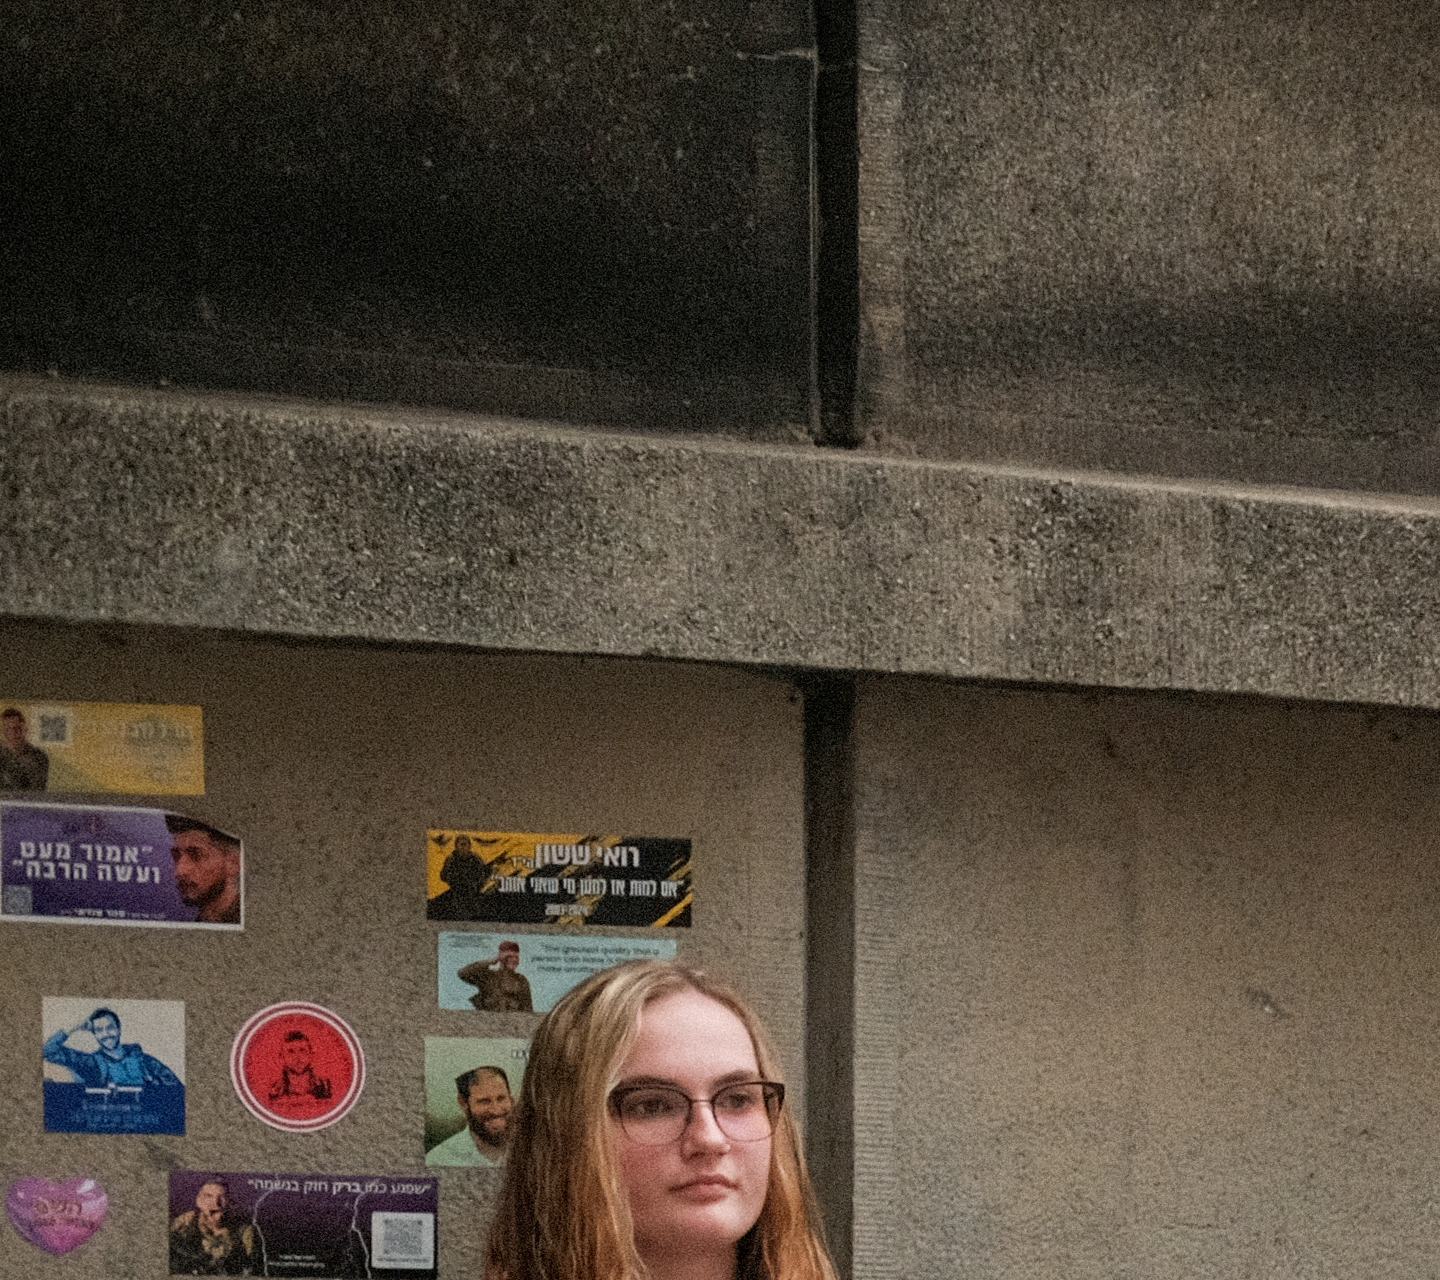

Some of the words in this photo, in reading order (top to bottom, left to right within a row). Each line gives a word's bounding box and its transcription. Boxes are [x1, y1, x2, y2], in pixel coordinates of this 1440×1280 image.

[20, 841, 72, 860] מעט
[535, 843, 591, 869] ששון
[597, 845, 640, 867] רואי
[97, 864, 161, 884] ועשה
[332, 1181, 362, 1195] ברק
